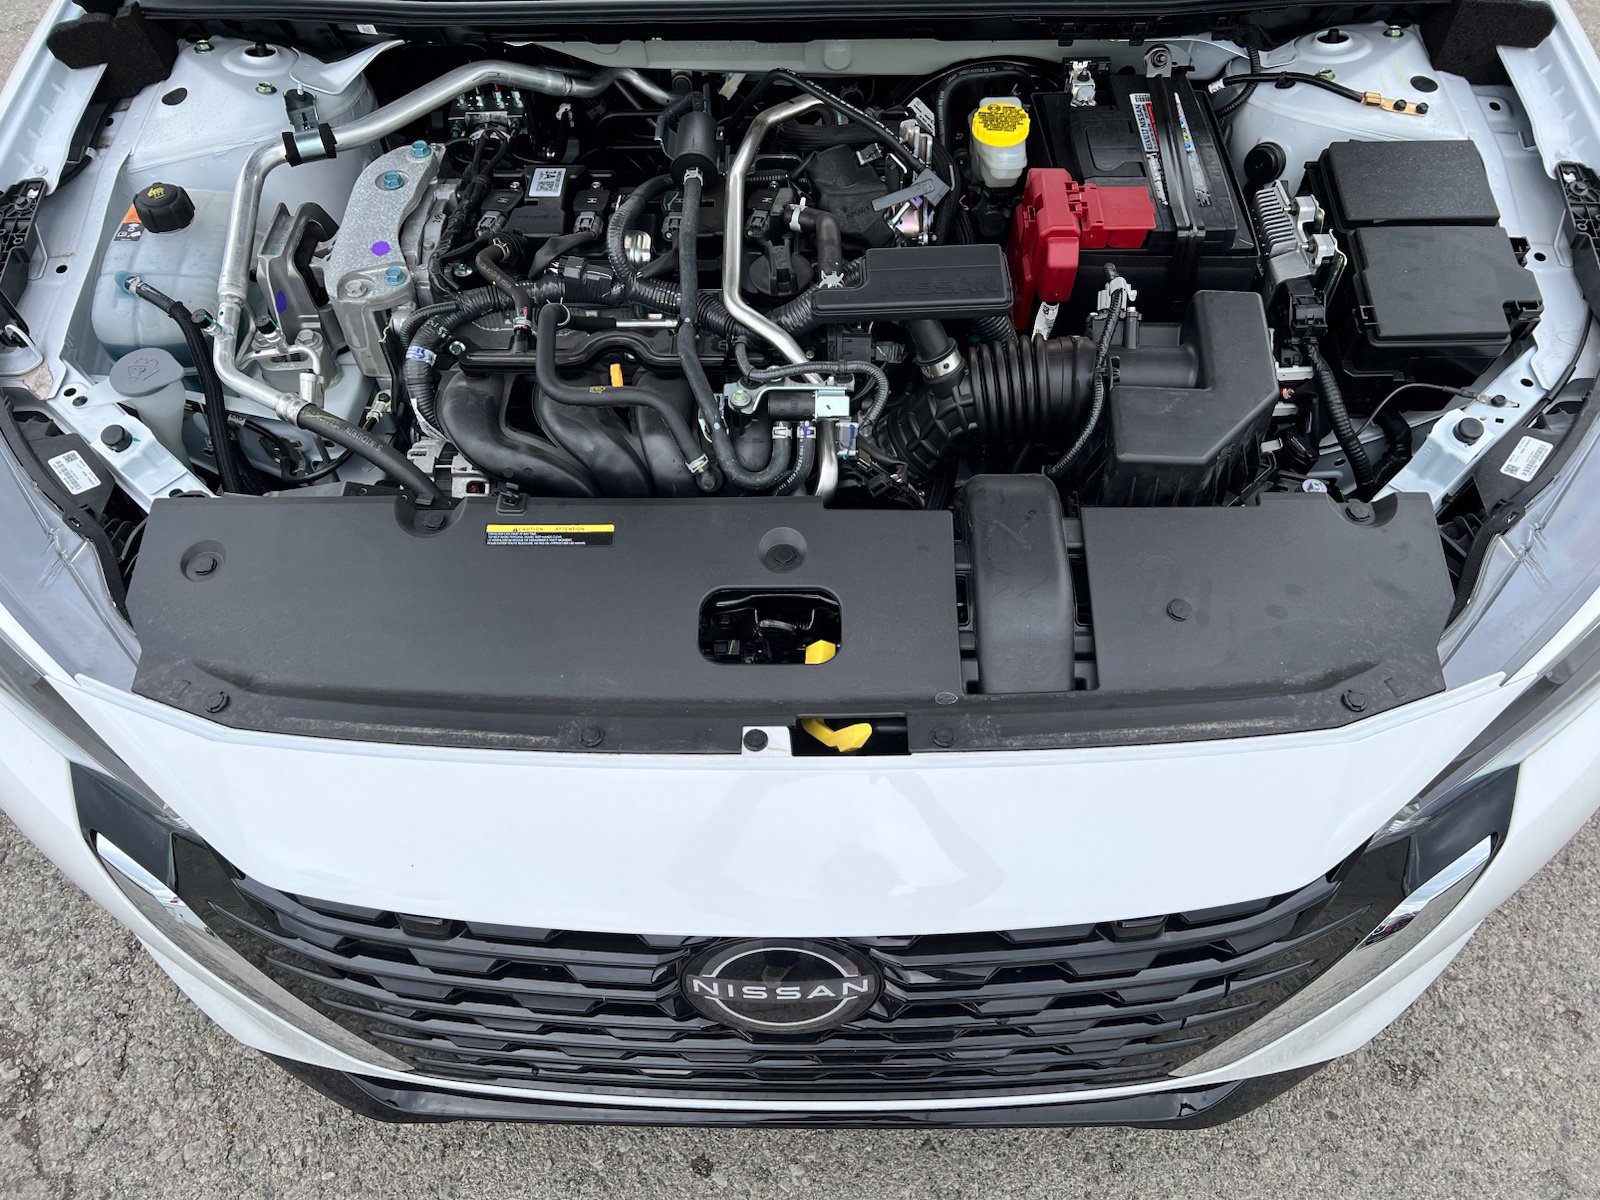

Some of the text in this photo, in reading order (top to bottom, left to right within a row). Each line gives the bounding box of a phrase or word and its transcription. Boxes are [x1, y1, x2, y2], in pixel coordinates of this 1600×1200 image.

[1134, 104, 1147, 128] NISSAN
[880, 276, 999, 296] NISSAN
[692, 979, 868, 1000] NISSAN
